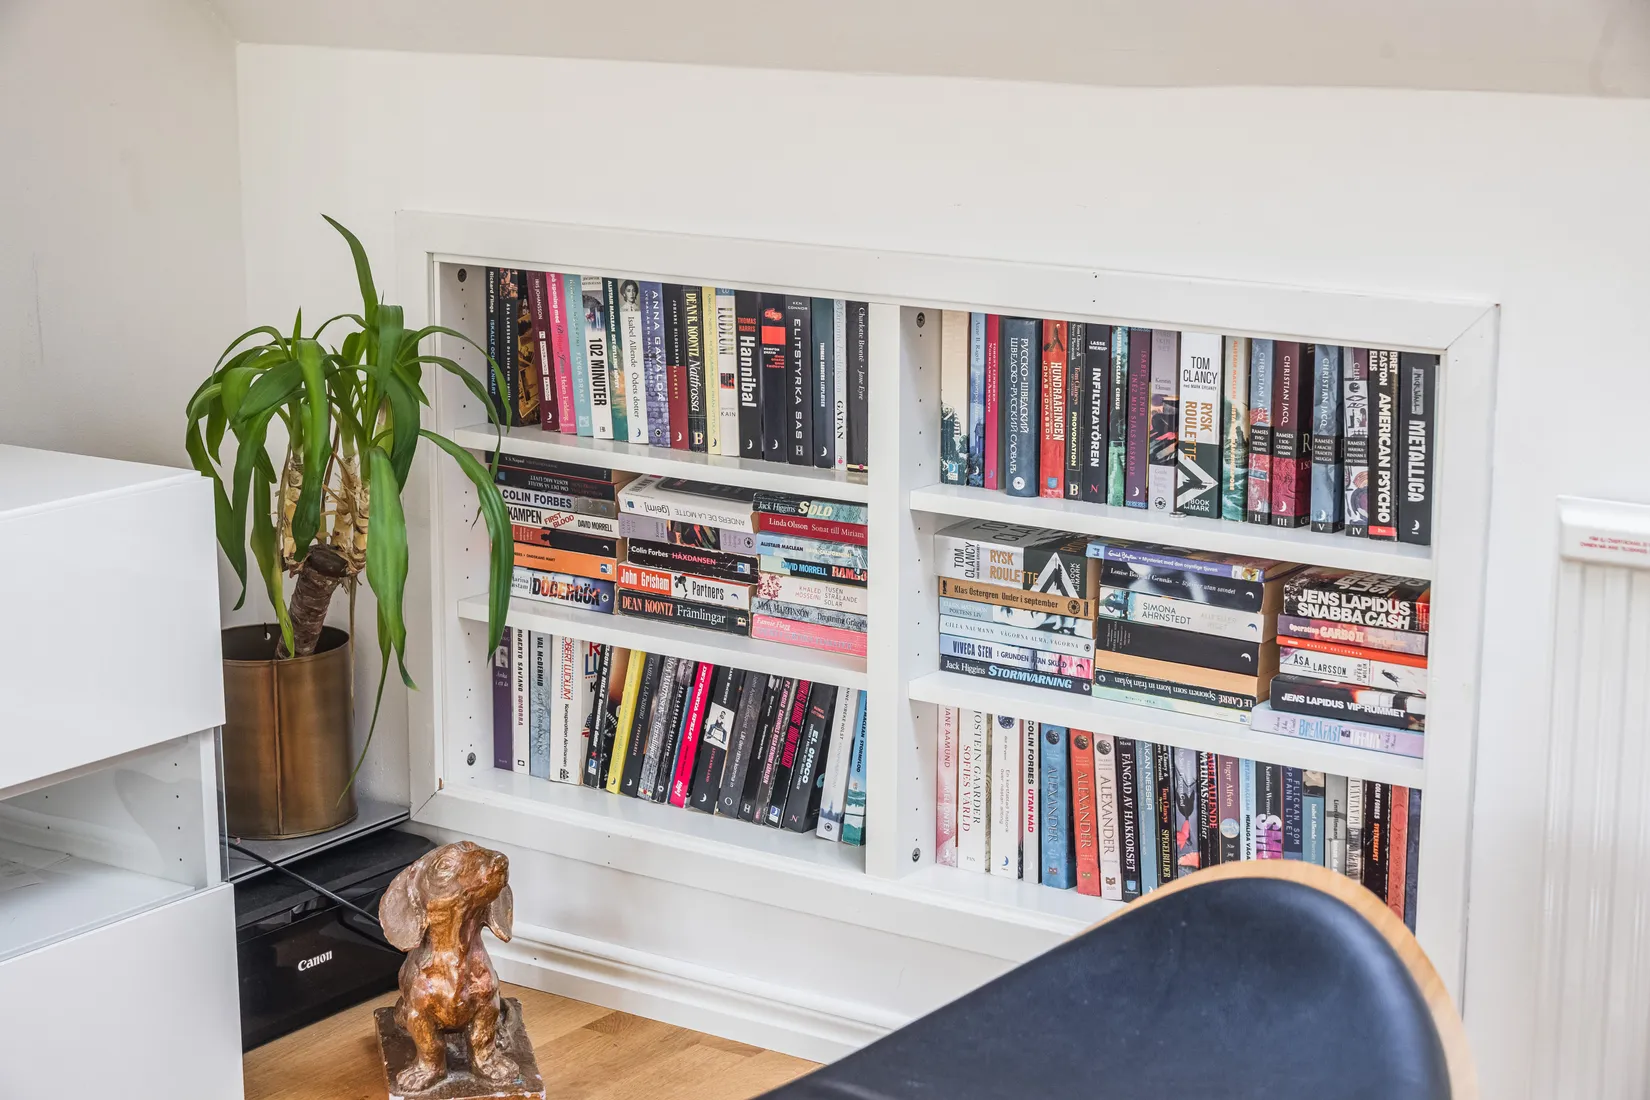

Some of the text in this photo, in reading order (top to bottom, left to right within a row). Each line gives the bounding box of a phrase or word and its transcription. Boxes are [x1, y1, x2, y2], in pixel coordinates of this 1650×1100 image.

[628, 316, 636, 337] Isabel
[718, 308, 734, 355] LUDLUM
[688, 327, 699, 356] KOONTZ
[589, 338, 607, 406] 102 MINUTER
[655, 337, 665, 401] GAVALDA
[740, 336, 757, 407] Hannibal
[794, 318, 802, 404] ELITSTYRKA
[1191, 356, 1210, 370] TOM
[1379, 351, 1387, 386] EASTON
[1390, 352, 1398, 374] BRET
[1183, 370, 1218, 384] CLANCY
[1050, 362, 1064, 440] HUNDRAÅRINGEN
[1090, 368, 1101, 467] INFILTRATÖREN
[1200, 402, 1212, 432] RYSK
[1184, 401, 1197, 460] ROULETTE
[1378, 393, 1391, 523] AMERICAN PSYCHO
[1408, 420, 1426, 502] METALLICA
[503, 490, 572, 508] COLIN FORBES
[759, 501, 795, 513] Jack Higgins
[798, 501, 833, 516] SOLO
[544, 512, 562, 524] FIRST
[553, 515, 574, 528] BLOOD
[675, 508, 697, 518] MOTTE
[718, 515, 745, 526] ANDERS
[1278, 518, 1287, 526] III
[578, 520, 590, 529] DAVID
[592, 522, 613, 532] MORRELL
[769, 518, 786, 527] Linda
[788, 521, 808, 530] Olsson
[811, 524, 829, 533] Sonat
[841, 529, 865, 538] Miriam
[631, 546, 716, 565] Colin Forbes HÄXDANSEN
[954, 548, 964, 568] TOM
[964, 542, 975, 579] CLANCY
[990, 549, 1014, 565] RYSK
[781, 561, 827, 576] DAVID MORRELL
[990, 566, 1039, 585] ROULETTE
[1110, 568, 1172, 584] Louise Gennäs
[621, 568, 724, 600] John Grisham Partners
[795, 592, 821, 600] HOSSEINI
[825, 593, 858, 603] STRÅLANDE
[954, 585, 1058, 609] Klas Östergren Under september
[1298, 589, 1411, 615] JENS LAPIDUS
[622, 596, 726, 625] DEAN KOONTZ Främlingar
[1142, 612, 1192, 625] AHRNSTEDT
[1143, 602, 1176, 614] SIMONA
[1298, 603, 1410, 629] SNABBA CASH
[1320, 626, 1355, 640] GARBO
[953, 641, 993, 658] VIVECA STEN
[1000, 651, 1029, 662] GRUNDEN
[945, 660, 1072, 689] Jack Higgins STORMVARNING
[1293, 653, 1347, 675] ÅSA LARSSON
[639, 658, 654, 719] CAMILLA LÄCKBERG
[1114, 676, 1132, 687] kylan
[1133, 680, 1147, 690] från
[1156, 682, 1172, 693] kom
[1189, 687, 1216, 701] Spionen
[1218, 694, 1243, 707] CARRÉ
[1281, 693, 1405, 717] JENS LAPIDUS VIP-RUMMET
[973, 765, 981, 824] GAARDER
[1047, 766, 1058, 844] ALEXANDER
[962, 791, 970, 832] VÄRLD
[1077, 771, 1092, 848] ALEXANDER
[1100, 776, 1115, 854] ALEXANDER
[1122, 753, 1136, 872] FÅNGAD AV HAKKORSET
[1209, 784, 1217, 829] ALLENDE
[298, 950, 333, 972] Canon
